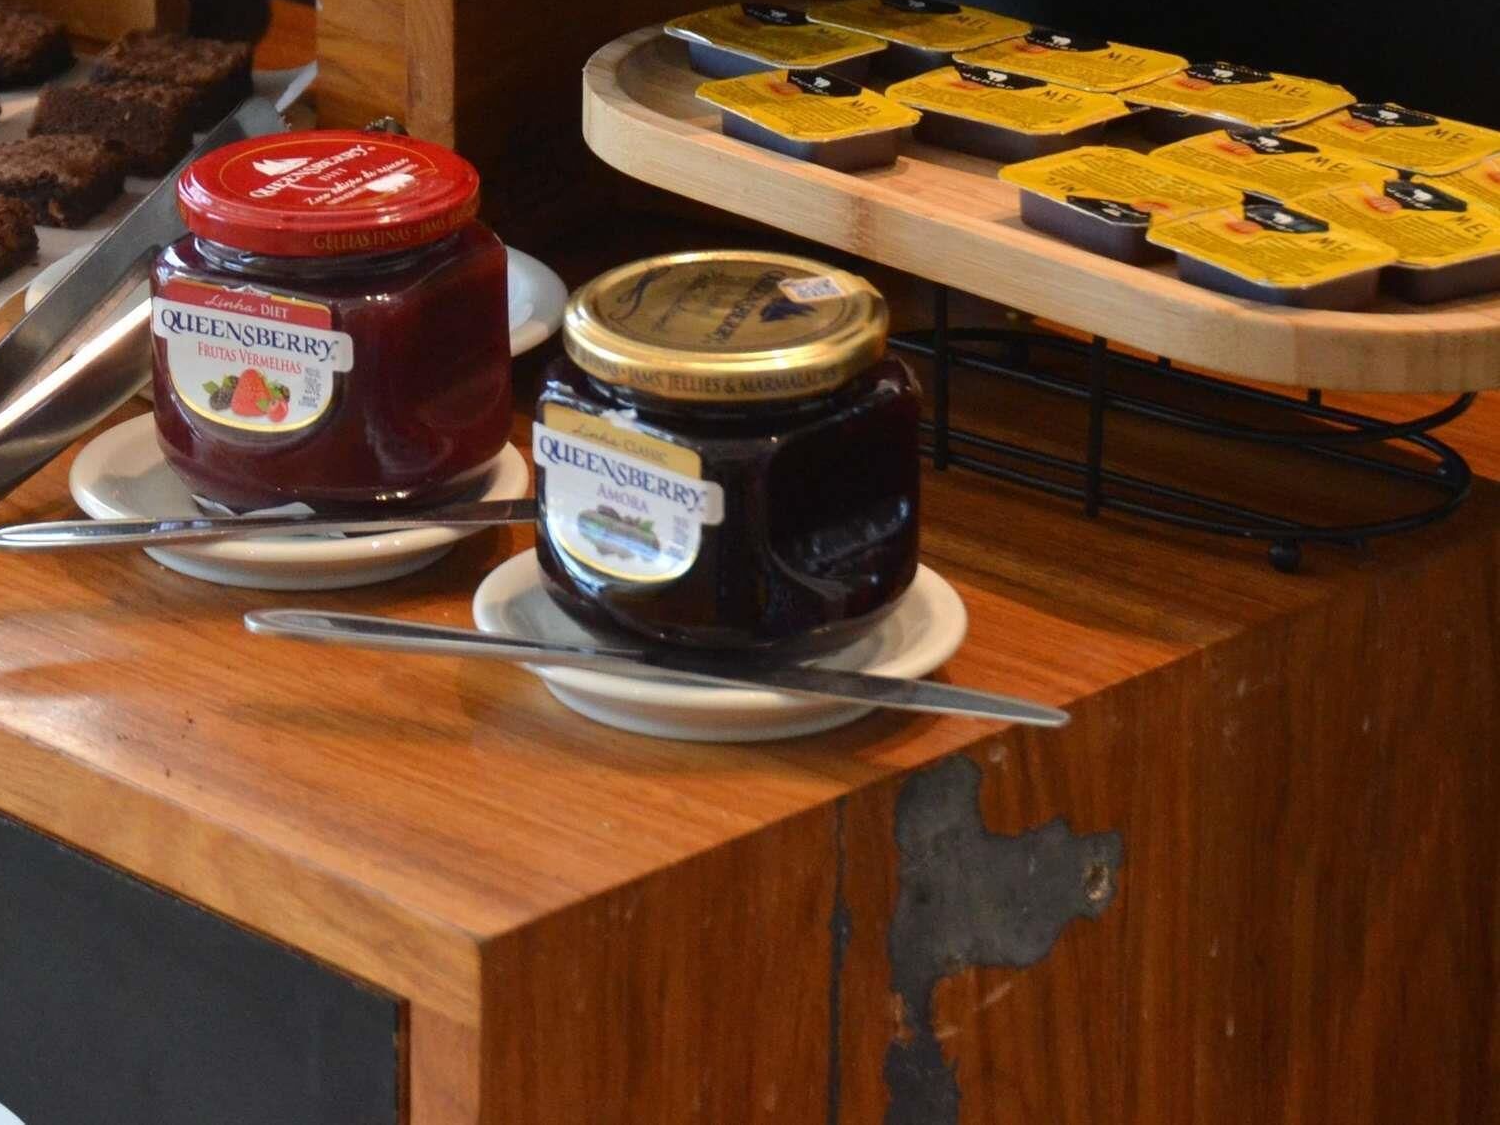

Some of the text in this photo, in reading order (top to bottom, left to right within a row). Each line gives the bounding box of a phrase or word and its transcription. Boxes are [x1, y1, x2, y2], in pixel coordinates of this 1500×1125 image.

[1099, 50, 1148, 67] MEL
[1037, 89, 1086, 107] MEL
[1266, 83, 1311, 100] MEL
[1426, 128, 1474, 146] MEL
[1306, 155, 1354, 173] MEL
[1452, 216, 1493, 241] MEL
[204, 294, 290, 319] Linha DIET
[161, 308, 339, 362] QUEENSBERRY
[539, 435, 706, 513] QUEENSBERRY
